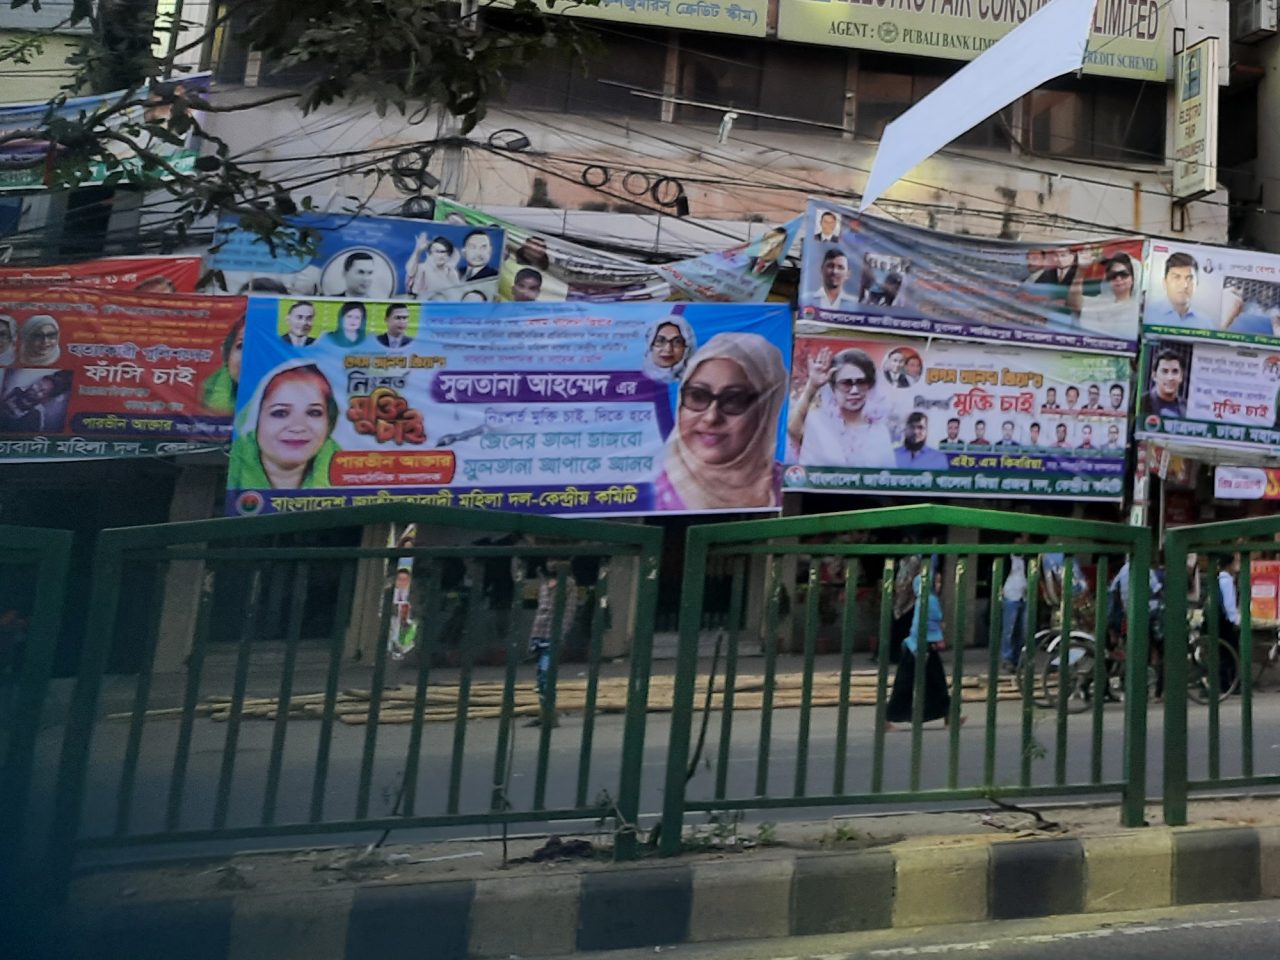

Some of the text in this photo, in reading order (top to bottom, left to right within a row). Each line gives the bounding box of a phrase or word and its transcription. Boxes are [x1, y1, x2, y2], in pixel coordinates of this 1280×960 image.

[828, 21, 867, 38] AGENT
[902, 27, 941, 47] PUBALI
[942, 34, 970, 51] BANK
[819, 311, 865, 324] বাংলাদেশ
[867, 316, 932, 330] জাতীয়তাবাদী
[84, 360, 197, 387] ফাঁসি চাই
[347, 370, 410, 393] নিঃশর্ত
[526, 374, 611, 398] আহম্মেদ
[615, 381, 638, 395] এর
[952, 386, 994, 417] মুক্তি
[1000, 391, 1035, 414] চাই
[1212, 399, 1269, 420] মুক্তি চাই
[82, 415, 128, 431] পারভীন
[132, 418, 174, 432] আক্তার
[531, 408, 558, 425] মুক্তি
[594, 408, 624, 422] দিতে
[629, 409, 652, 423] হবে
[480, 431, 582, 449] জেলের তালা
[1216, 425, 1246, 440] ঢাকা
[55, 437, 107, 455] মহিলা
[335, 452, 453, 468] পারভীন আক্তার
[463, 458, 533, 481] সুলতানা
[538, 457, 602, 475] আপাকে
[808, 471, 861, 487] বাংলাদেশ
[863, 470, 933, 488] জাতীয়তাবাদী
[270, 495, 347, 512] বাংলাদেশ
[458, 489, 503, 510] মহিলা
[595, 485, 637, 505] কমিটি
